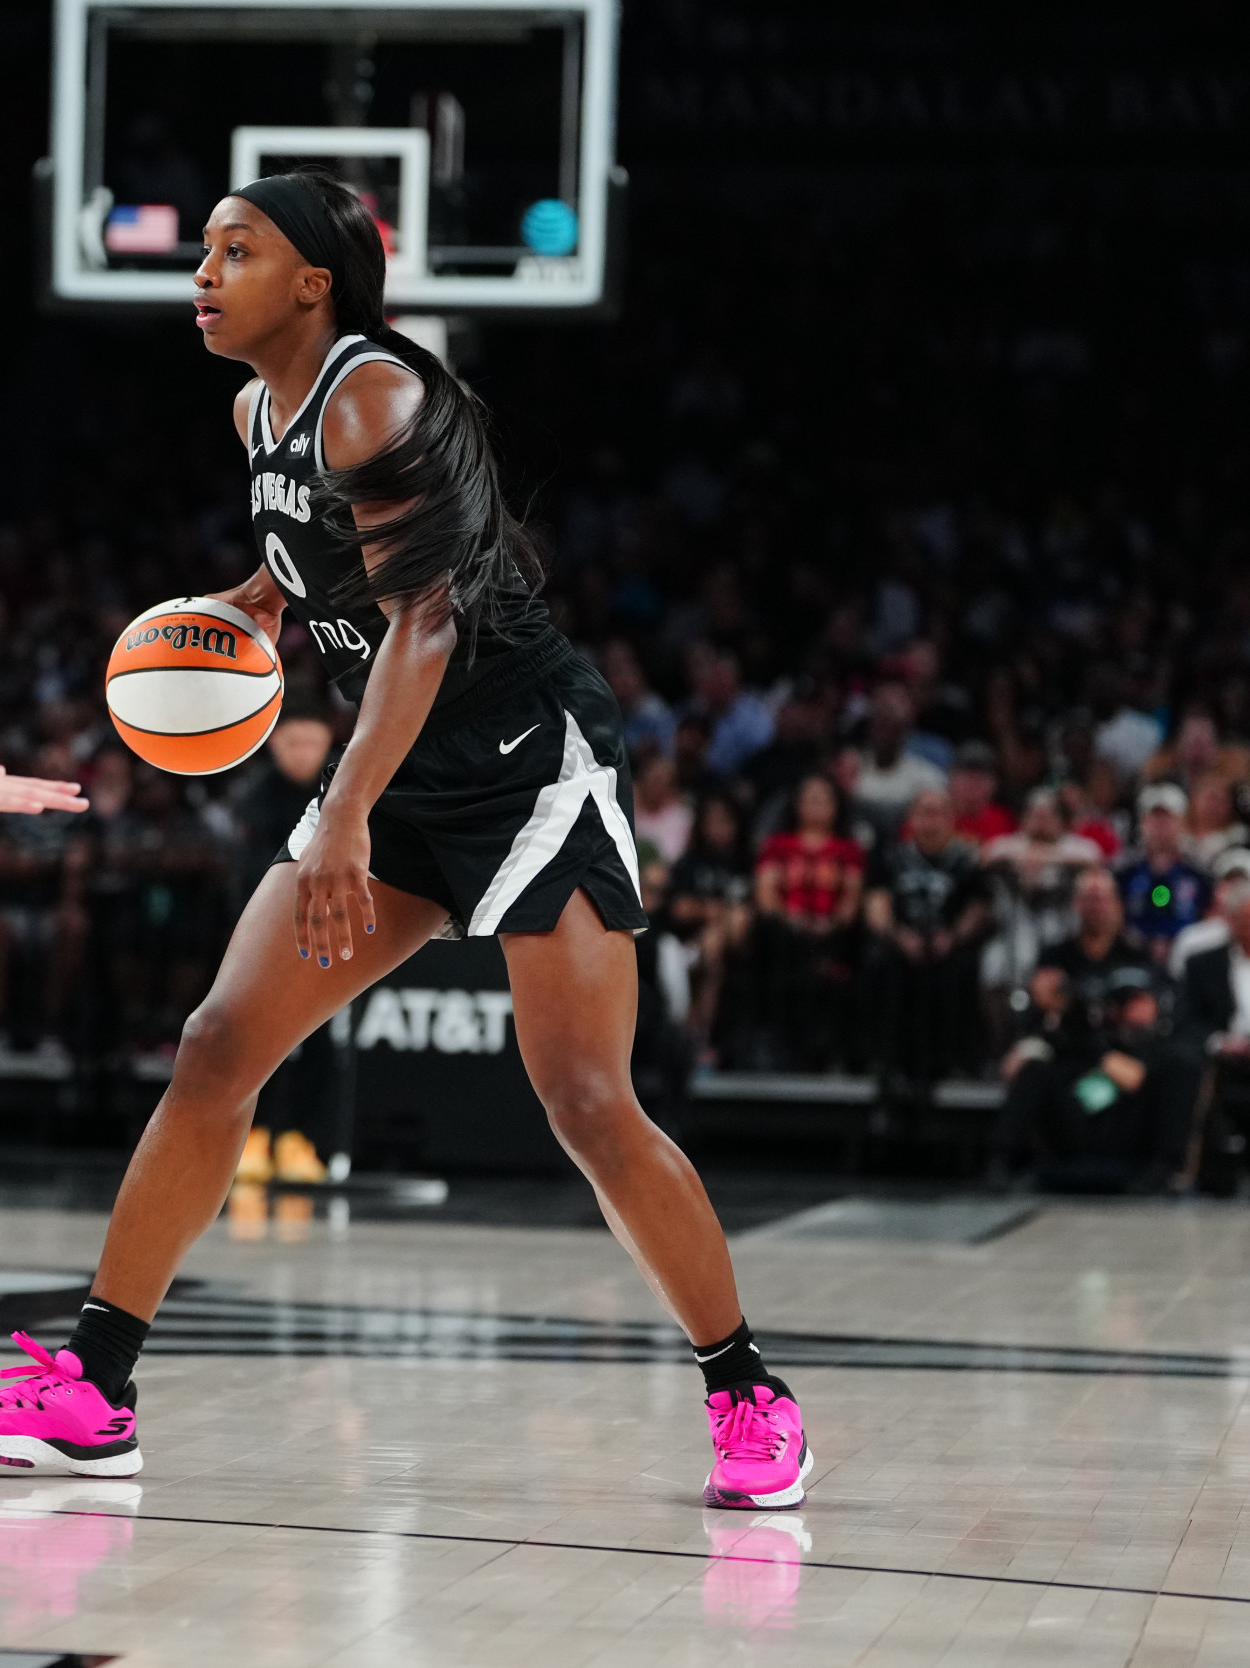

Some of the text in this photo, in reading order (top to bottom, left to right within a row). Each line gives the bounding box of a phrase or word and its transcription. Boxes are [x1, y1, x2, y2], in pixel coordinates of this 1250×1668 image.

[290, 433, 311, 456] ally
[262, 472, 311, 523] VEGAS
[265, 532, 307, 598] 0
[125, 624, 238, 660] Wilson
[355, 987, 513, 1055] AT&T
